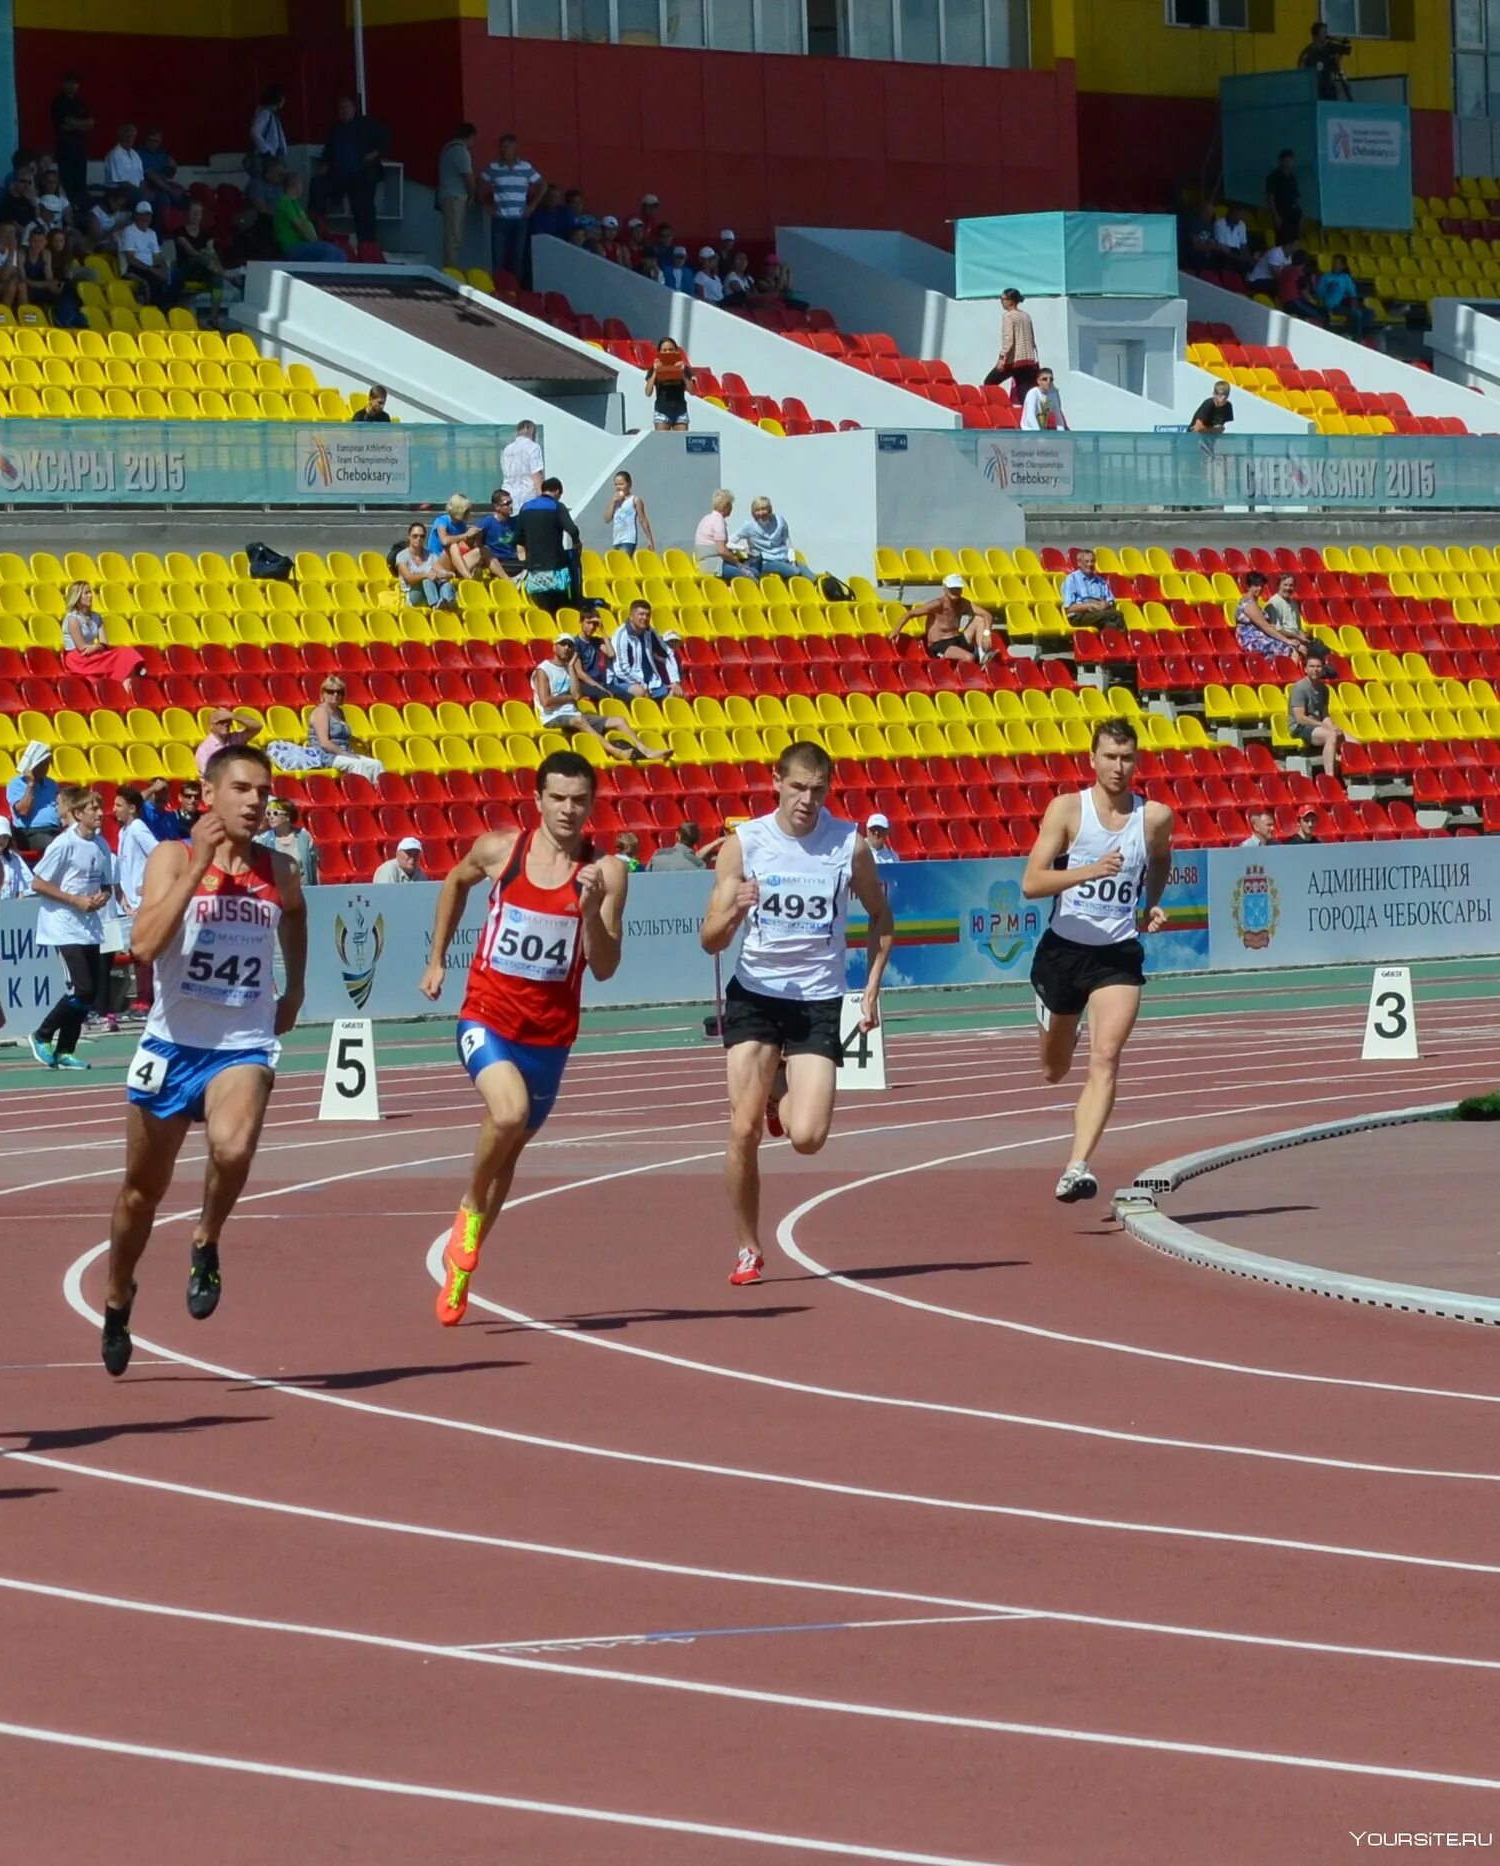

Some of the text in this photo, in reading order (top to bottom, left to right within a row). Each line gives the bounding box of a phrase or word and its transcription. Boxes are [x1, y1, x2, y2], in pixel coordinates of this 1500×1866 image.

[125, 450, 187, 493] 2015
[1245, 456, 1436, 499] CHEBOKSARY 2015
[781, 876, 826, 887] МАГНУМ
[1077, 879, 1133, 904] 506
[1307, 863, 1471, 899] АДМИНИСТРАЦИЯ
[196, 899, 272, 928] RUSSIA
[762, 892, 828, 920] 493
[972, 911, 1037, 934] ЮРМА
[1308, 897, 1492, 935] ГОРОДА ЧЕБОКСАРЫ
[627, 917, 693, 937] КУЛЬТУРЫ
[497, 928, 568, 966] 504
[187, 951, 262, 988] 542
[1373, 991, 1408, 1039] 3
[465, 1034, 476, 1054] 3
[841, 1020, 874, 1069] 4
[135, 1061, 153, 1086] 4
[335, 1038, 367, 1099] 5
